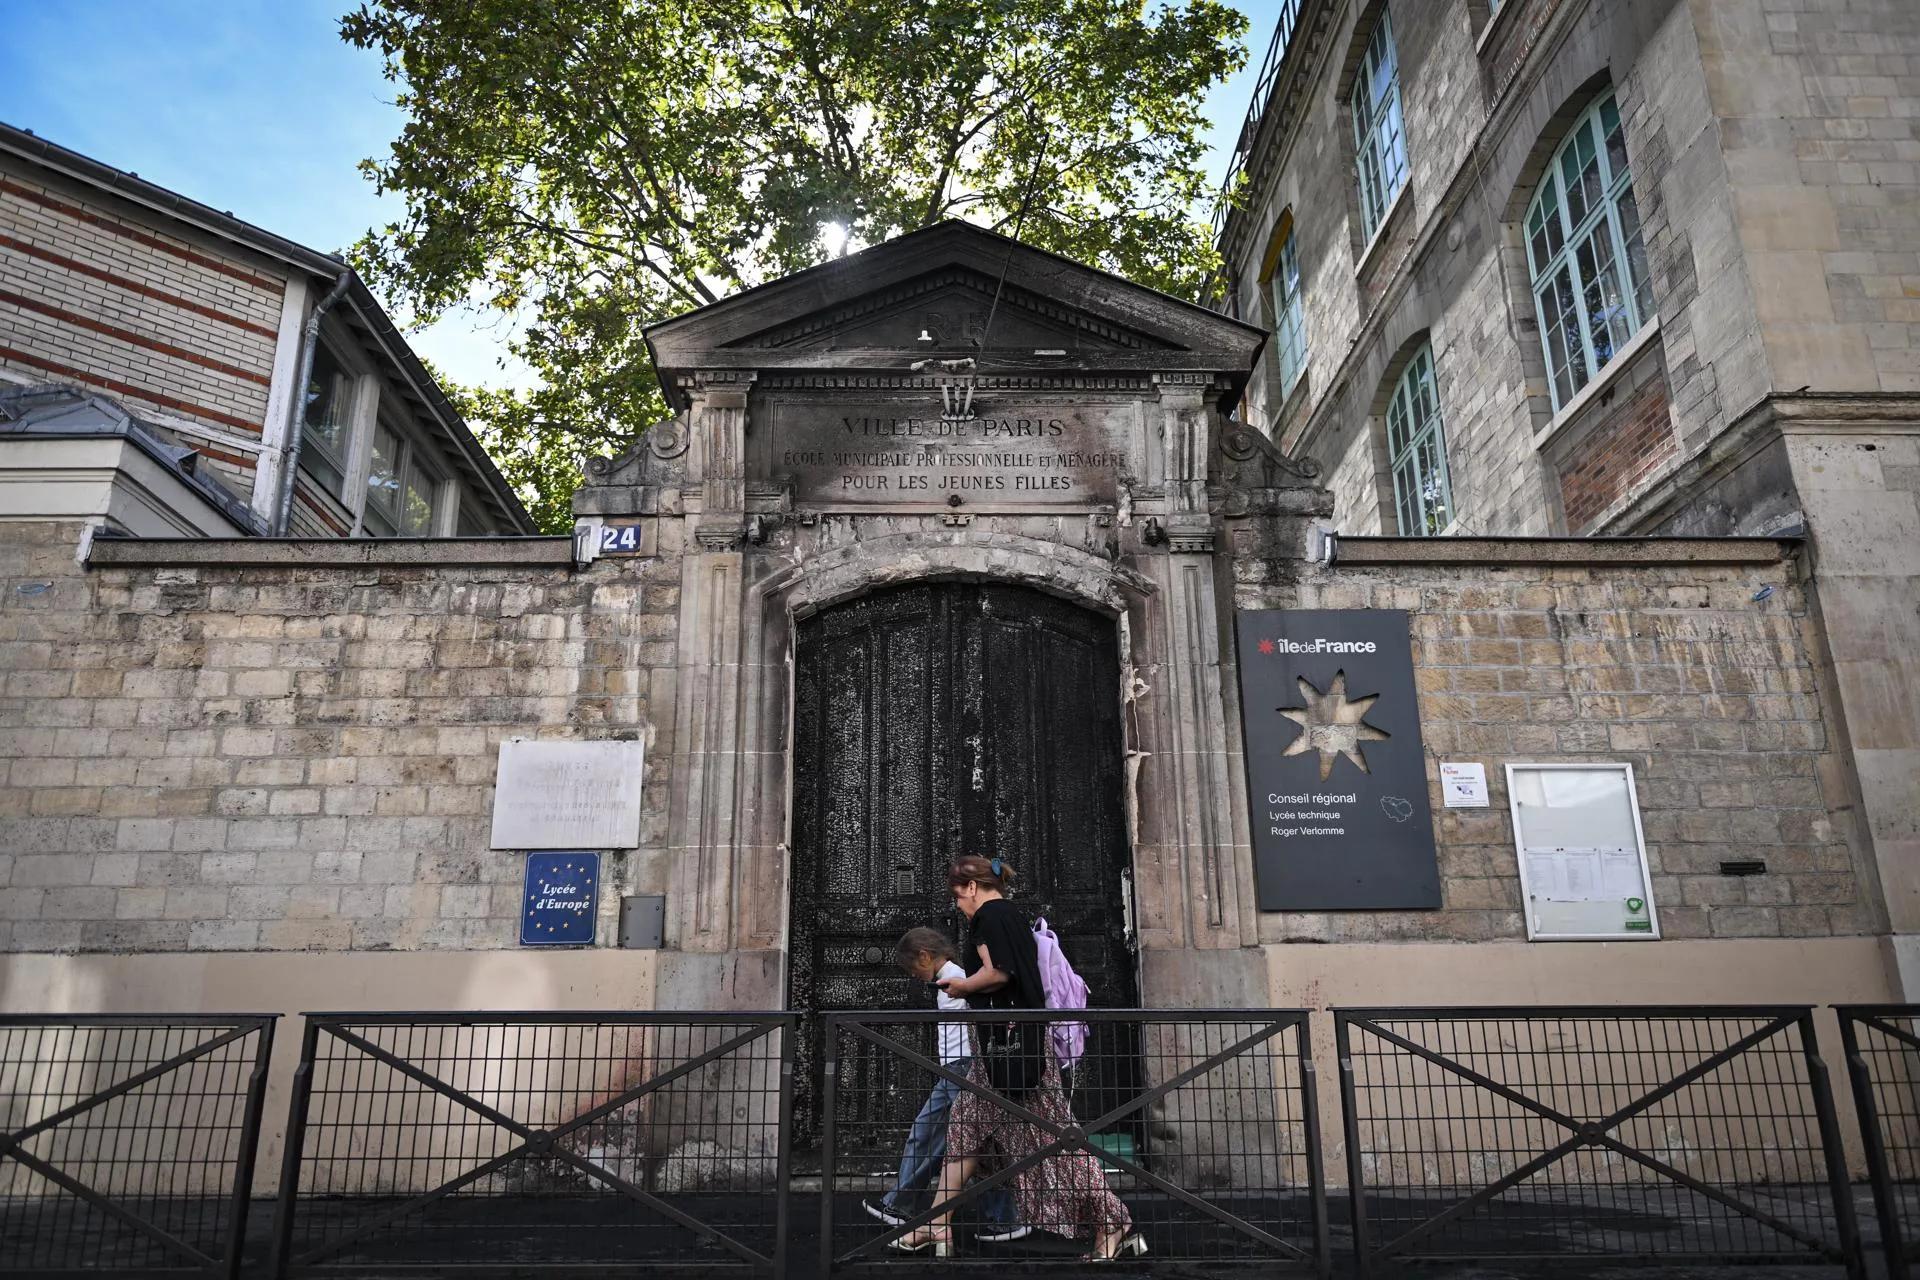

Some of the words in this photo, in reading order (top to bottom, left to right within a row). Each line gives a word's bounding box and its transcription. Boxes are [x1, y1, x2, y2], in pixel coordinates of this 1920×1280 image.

[843, 418, 923, 436] VILLE
[939, 420, 966, 436] DE
[983, 419, 1064, 437] PARIS
[833, 453, 910, 467] MUNICIPALE
[917, 453, 1033, 467] PROFESSIONNELLE
[842, 475, 889, 490] POUR
[899, 475, 928, 490] LES
[938, 475, 1005, 490] JEUNES
[1015, 476, 1071, 490] FILLES
[603, 527, 636, 549] 24
[1268, 793, 1309, 804] Conseil
[1312, 793, 1356, 806] régional
[1269, 811, 1296, 821] Lycée
[1297, 811, 1341, 821] technique
[1271, 827, 1298, 838] Roger
[1299, 827, 1345, 835] Verlomme
[542, 883, 577, 896] Lycée
[536, 898, 590, 911] d'Europe
